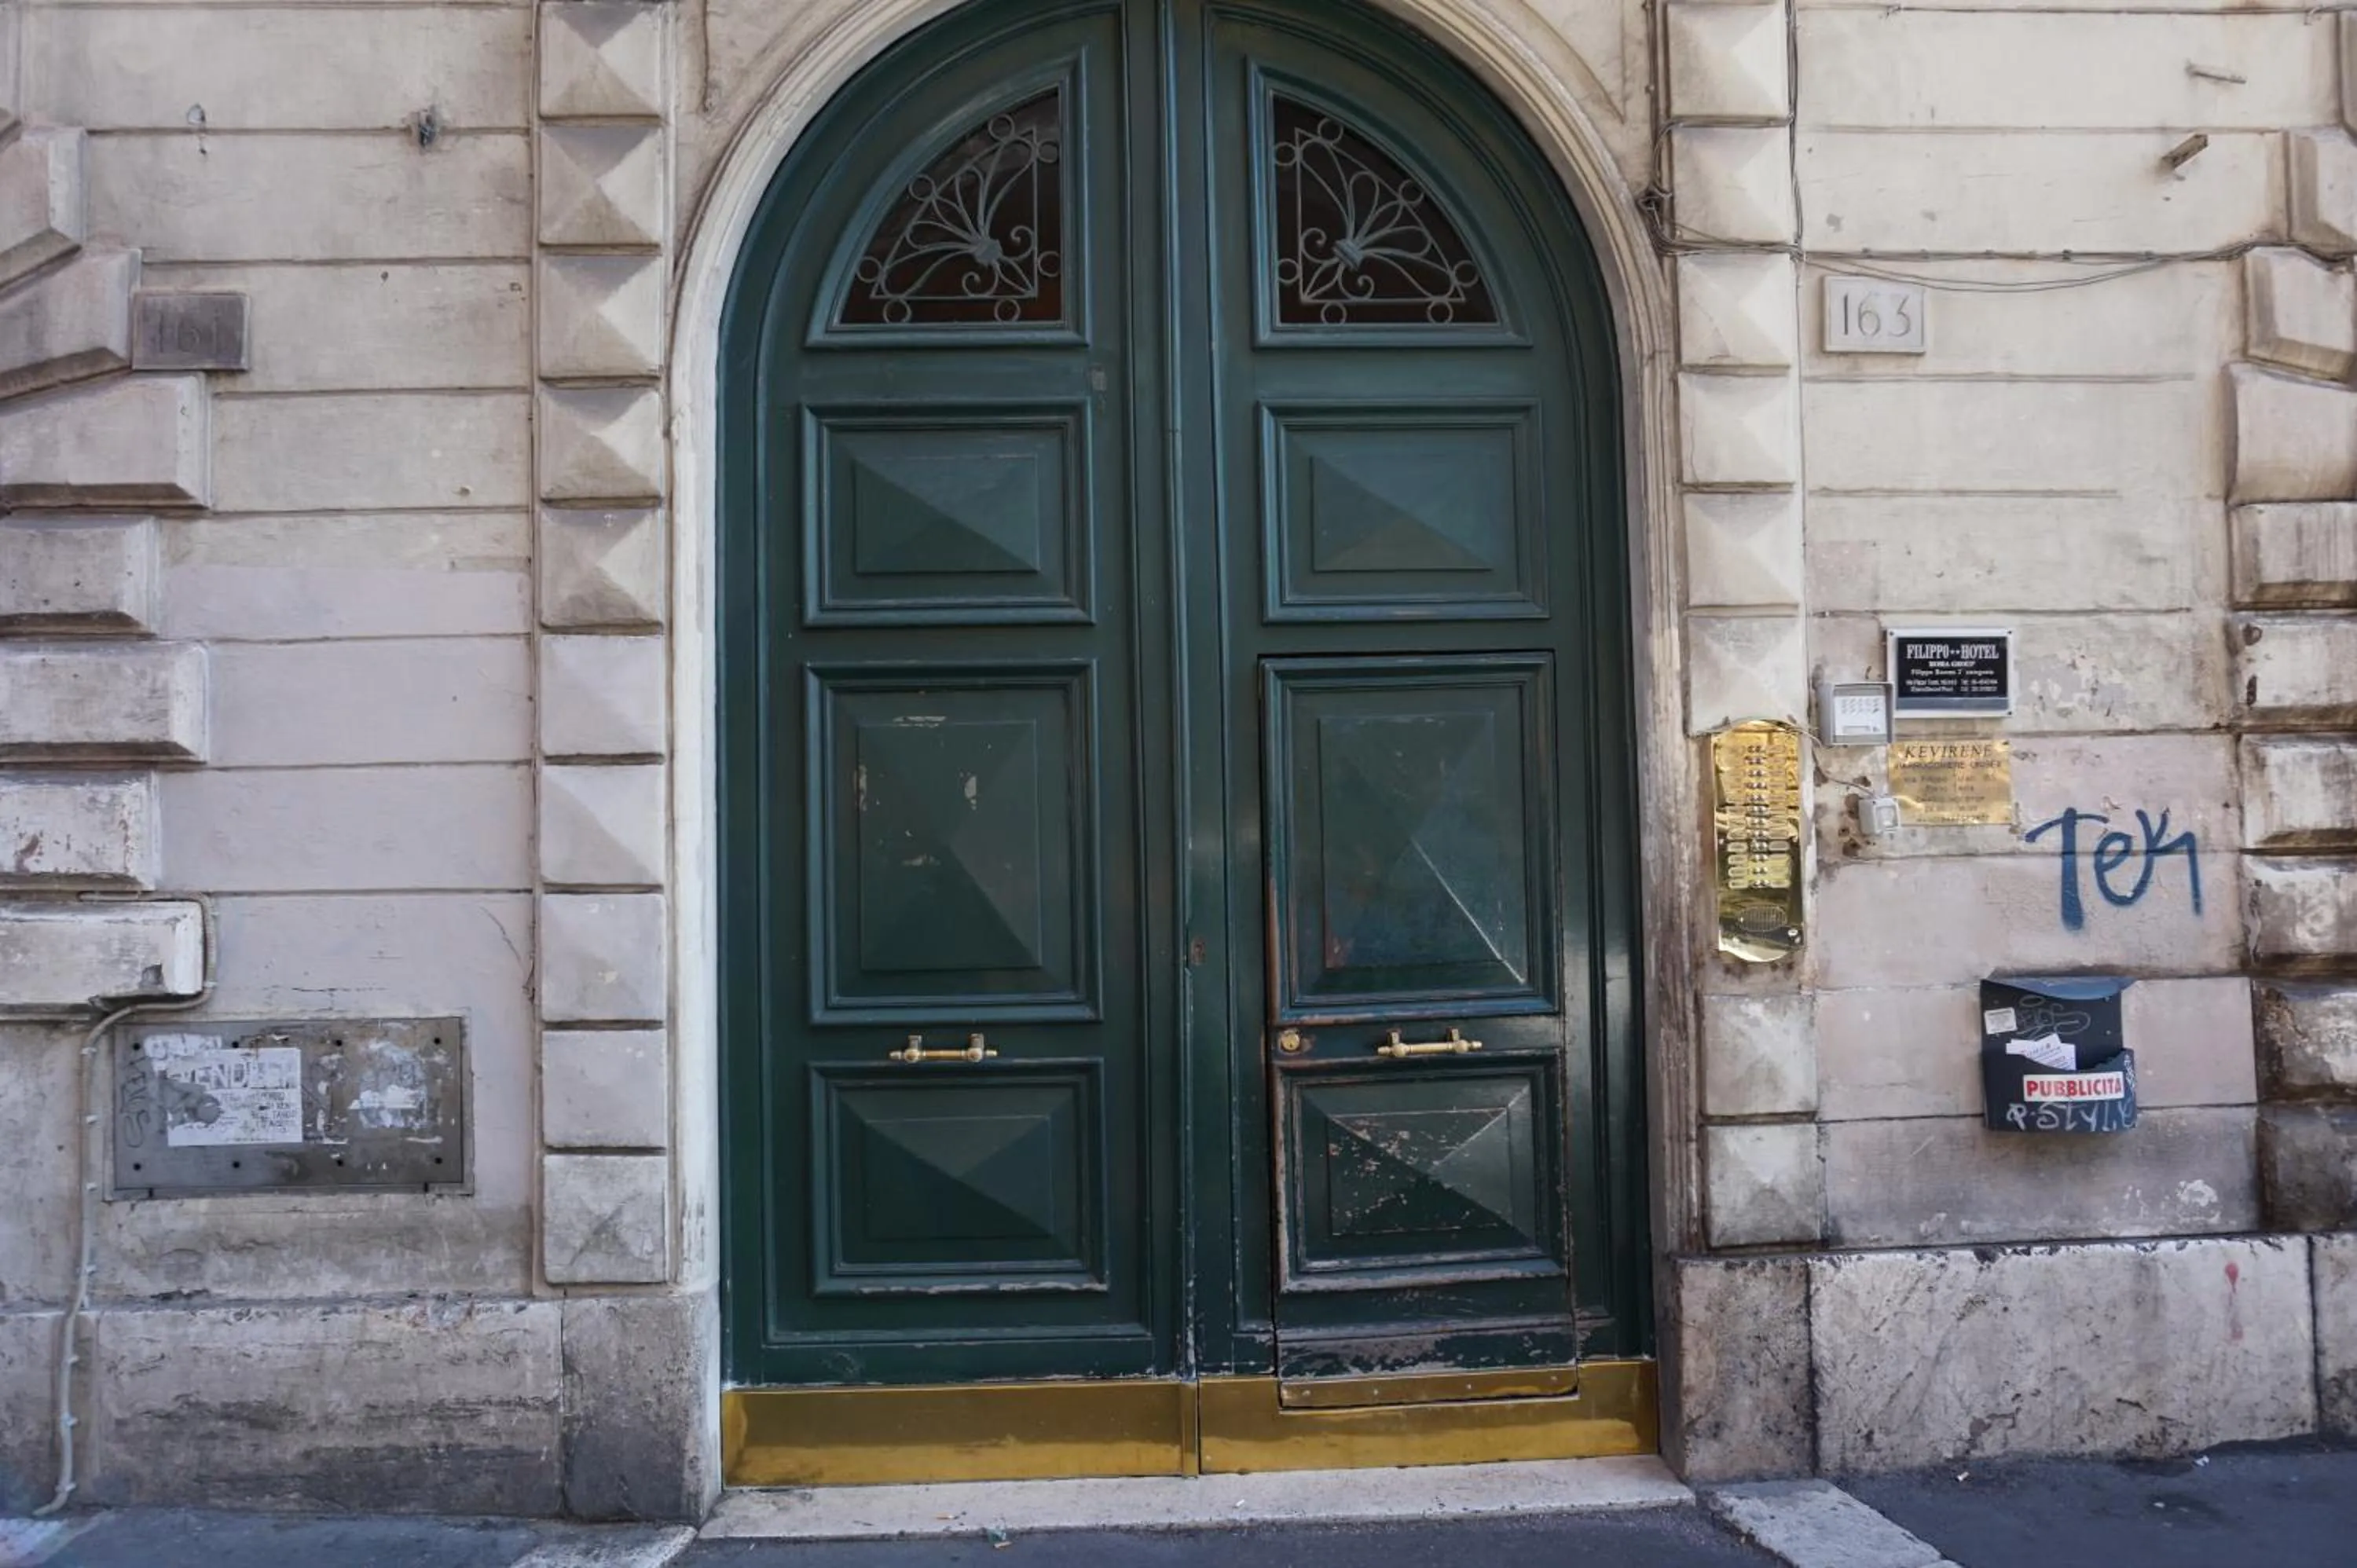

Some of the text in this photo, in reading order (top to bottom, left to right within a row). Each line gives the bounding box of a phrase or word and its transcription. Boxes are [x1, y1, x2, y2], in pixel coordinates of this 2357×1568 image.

[1842, 291, 1912, 339] 163
[1906, 643, 2000, 659] FILIPPO HOTEL
[1904, 744, 1993, 758] KEVIRENE
[2025, 1077, 2123, 1097] PUBBLICITA
